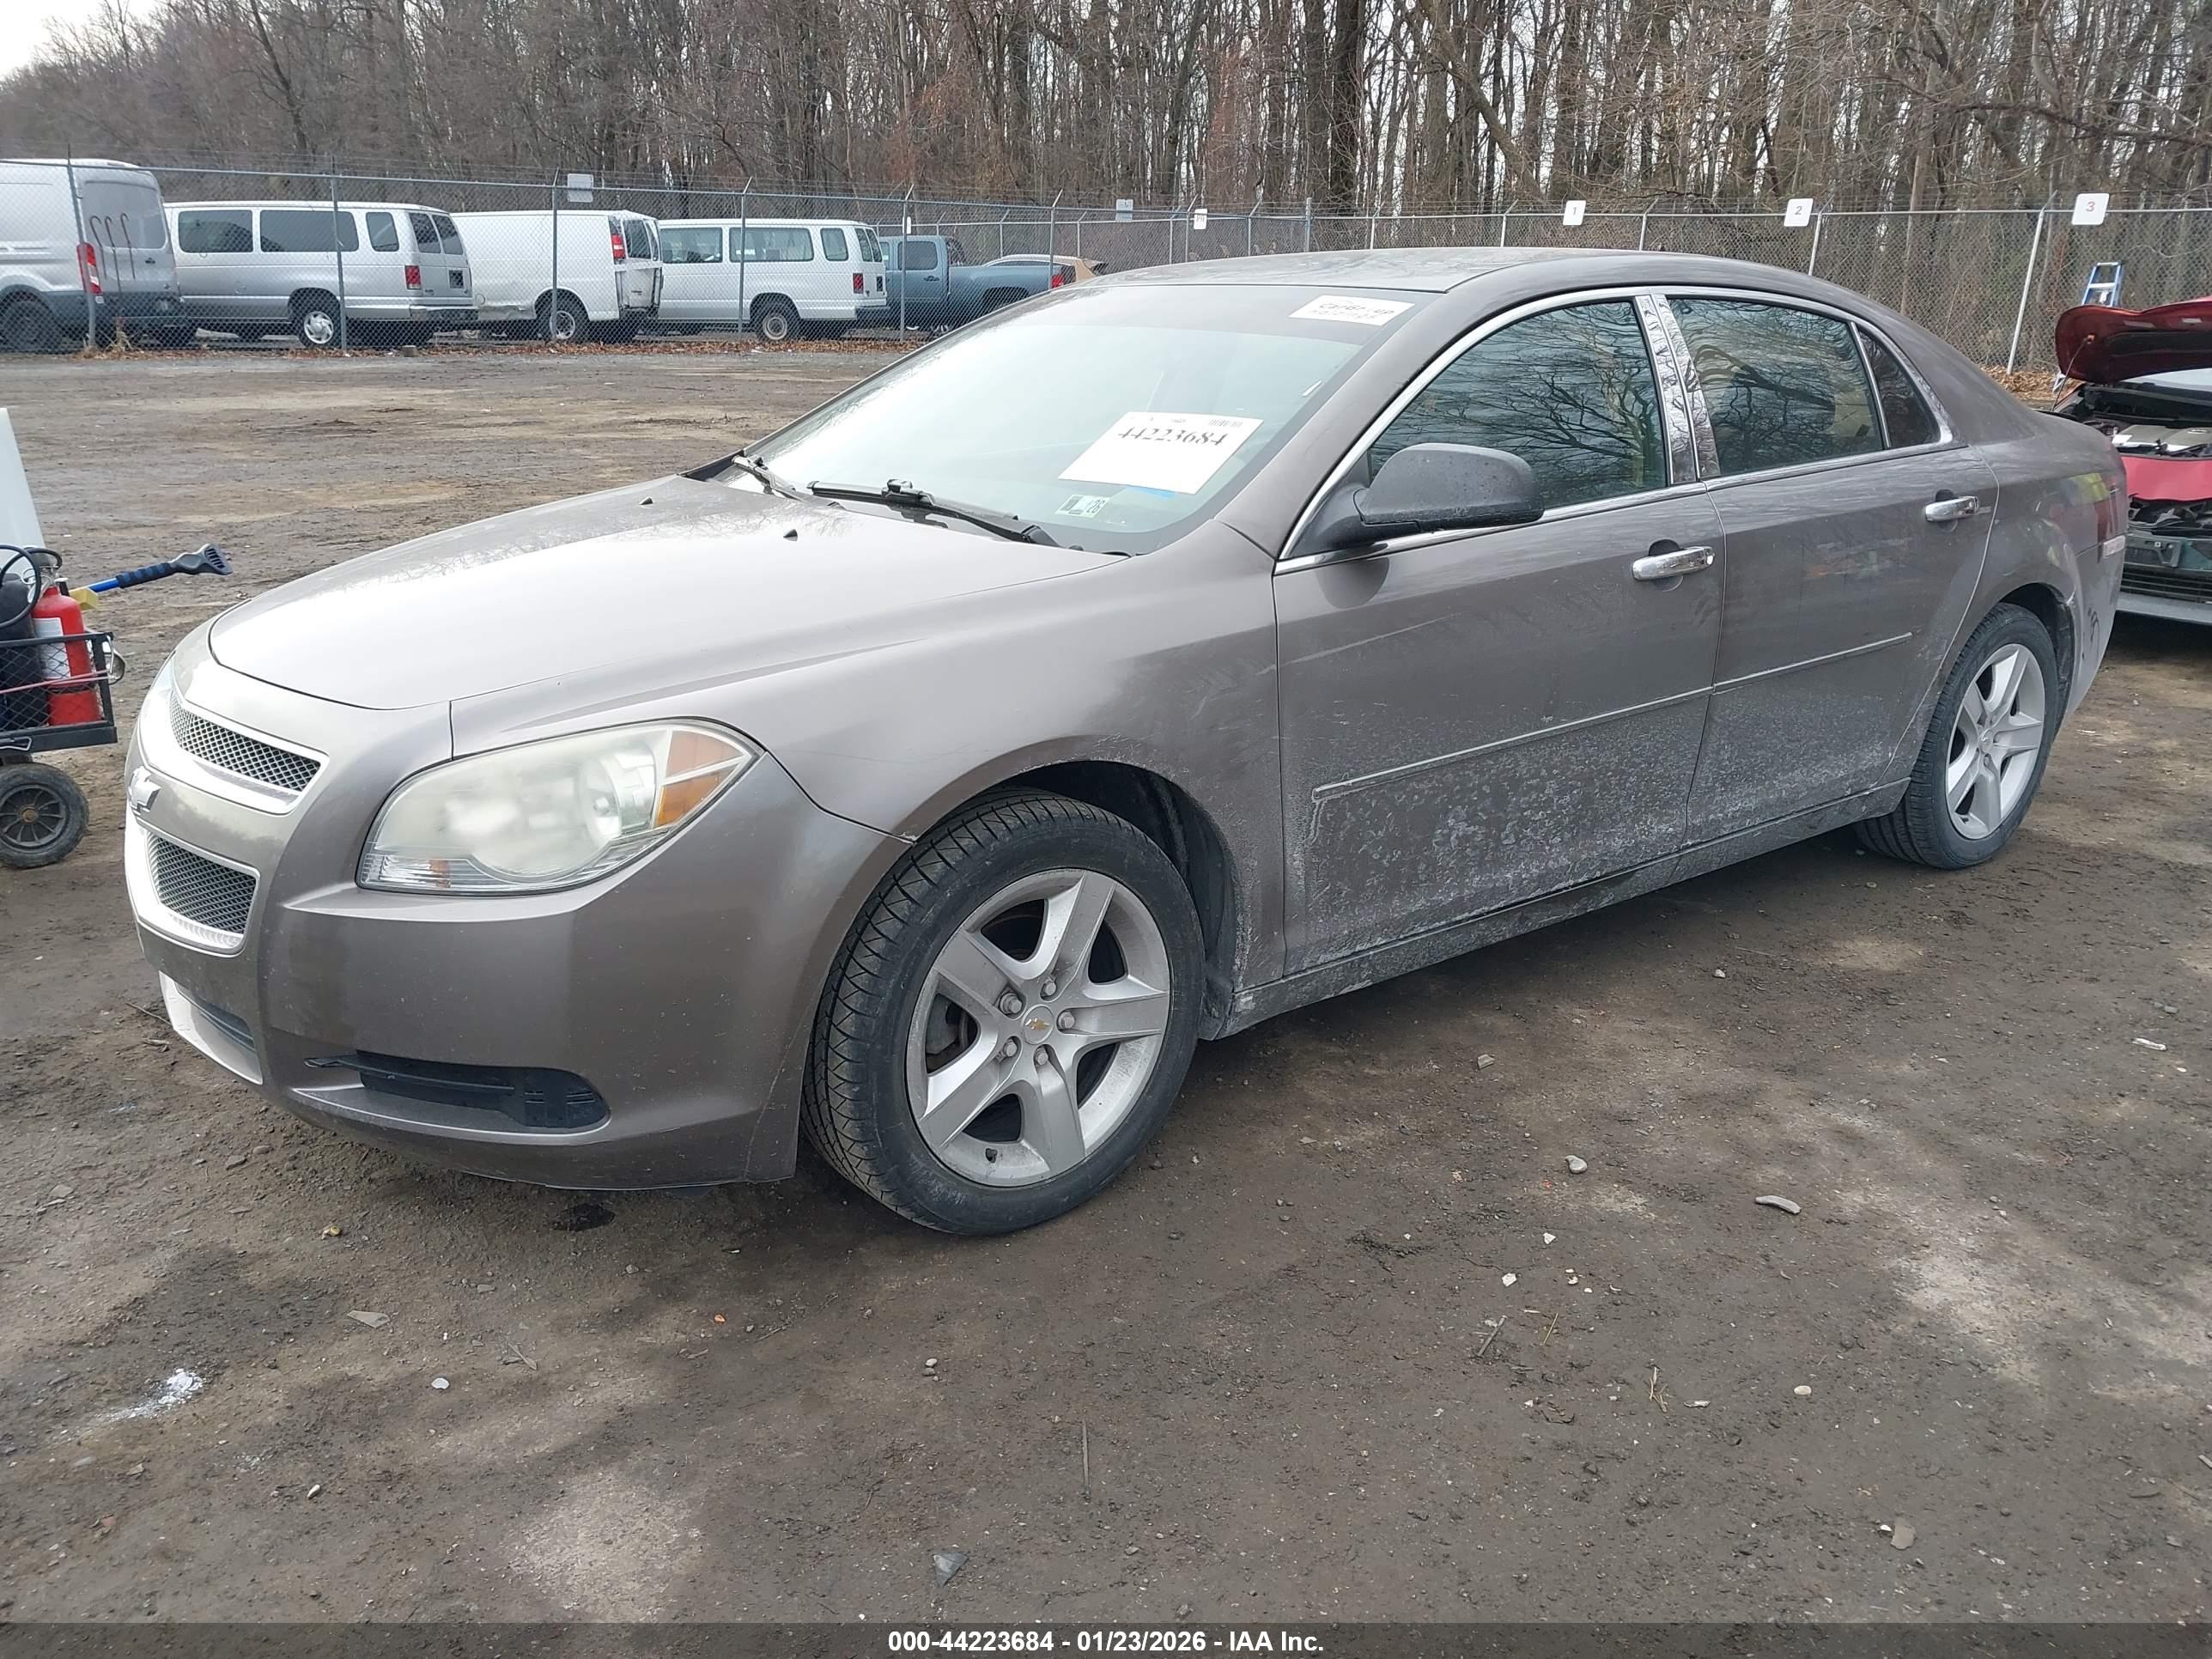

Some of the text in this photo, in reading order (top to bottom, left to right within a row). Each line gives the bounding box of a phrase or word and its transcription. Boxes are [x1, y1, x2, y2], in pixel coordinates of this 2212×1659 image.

[1793, 205, 1803, 216] 2
[2086, 201, 2096, 213] 3
[1117, 426, 1228, 447] 44223684
